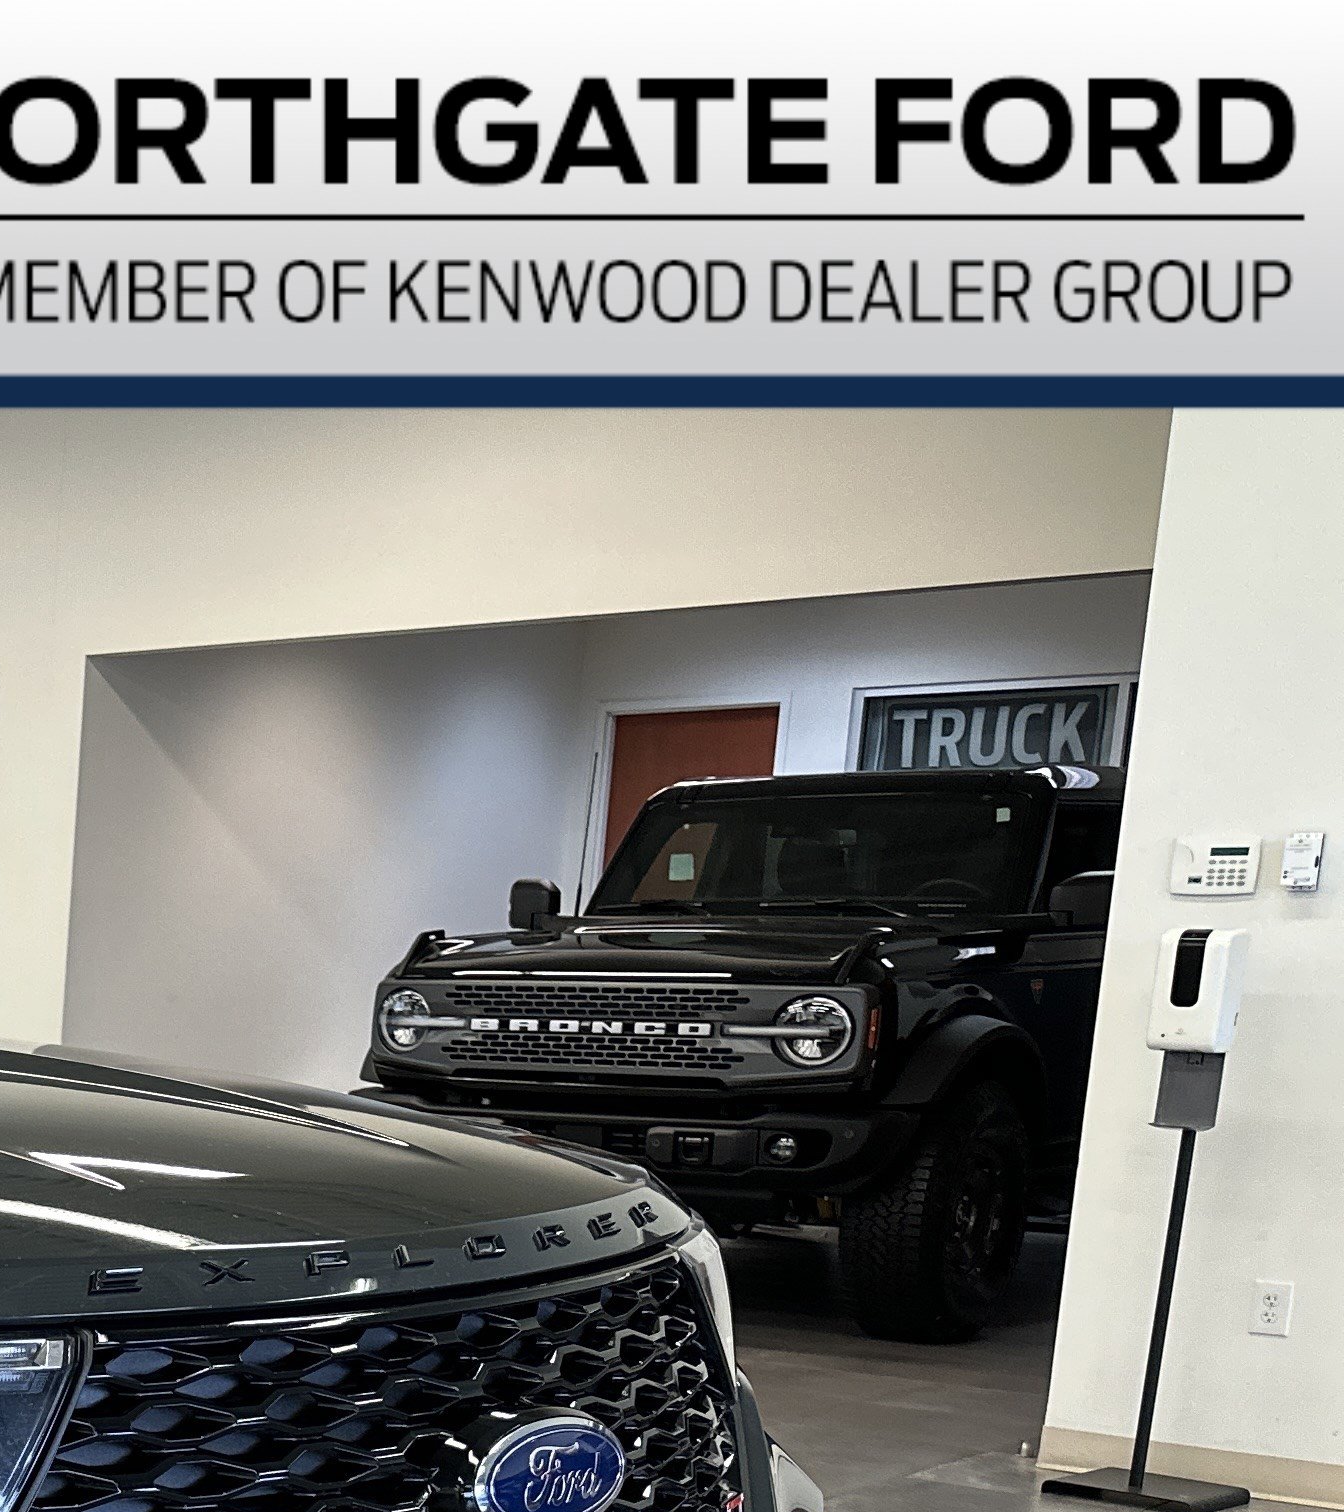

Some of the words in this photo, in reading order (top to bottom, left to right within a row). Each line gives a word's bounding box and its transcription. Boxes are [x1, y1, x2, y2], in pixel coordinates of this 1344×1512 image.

[892, 701, 1090, 769] TRUCK
[470, 1018, 711, 1036] BRONCO
[88, 1201, 659, 1296] EXPLORER
[523, 1441, 603, 1512] Ford
